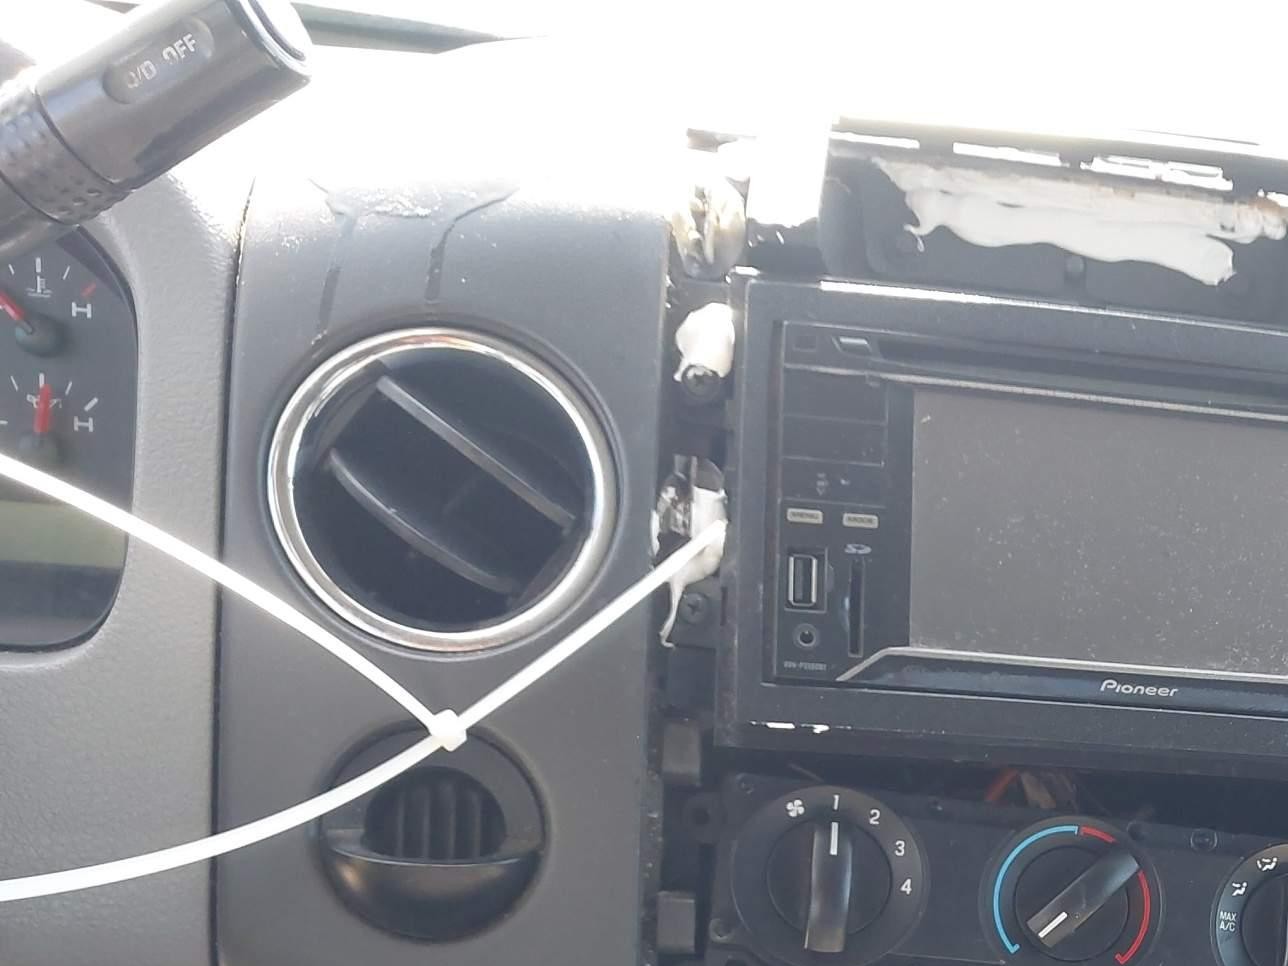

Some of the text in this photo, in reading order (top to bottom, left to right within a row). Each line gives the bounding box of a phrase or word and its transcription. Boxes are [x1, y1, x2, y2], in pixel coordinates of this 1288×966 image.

[162, 33, 196, 65] OFF
[71, 301, 92, 319] H
[73, 415, 94, 433] H
[1100, 679, 1179, 697] Pioneer
[833, 794, 840, 811] 1
[869, 808, 881, 825] 2
[894, 840, 906, 857] 3
[900, 878, 912, 895] 4
[1219, 911, 1237, 921] MAX
[1219, 920, 1236, 932] A/C
